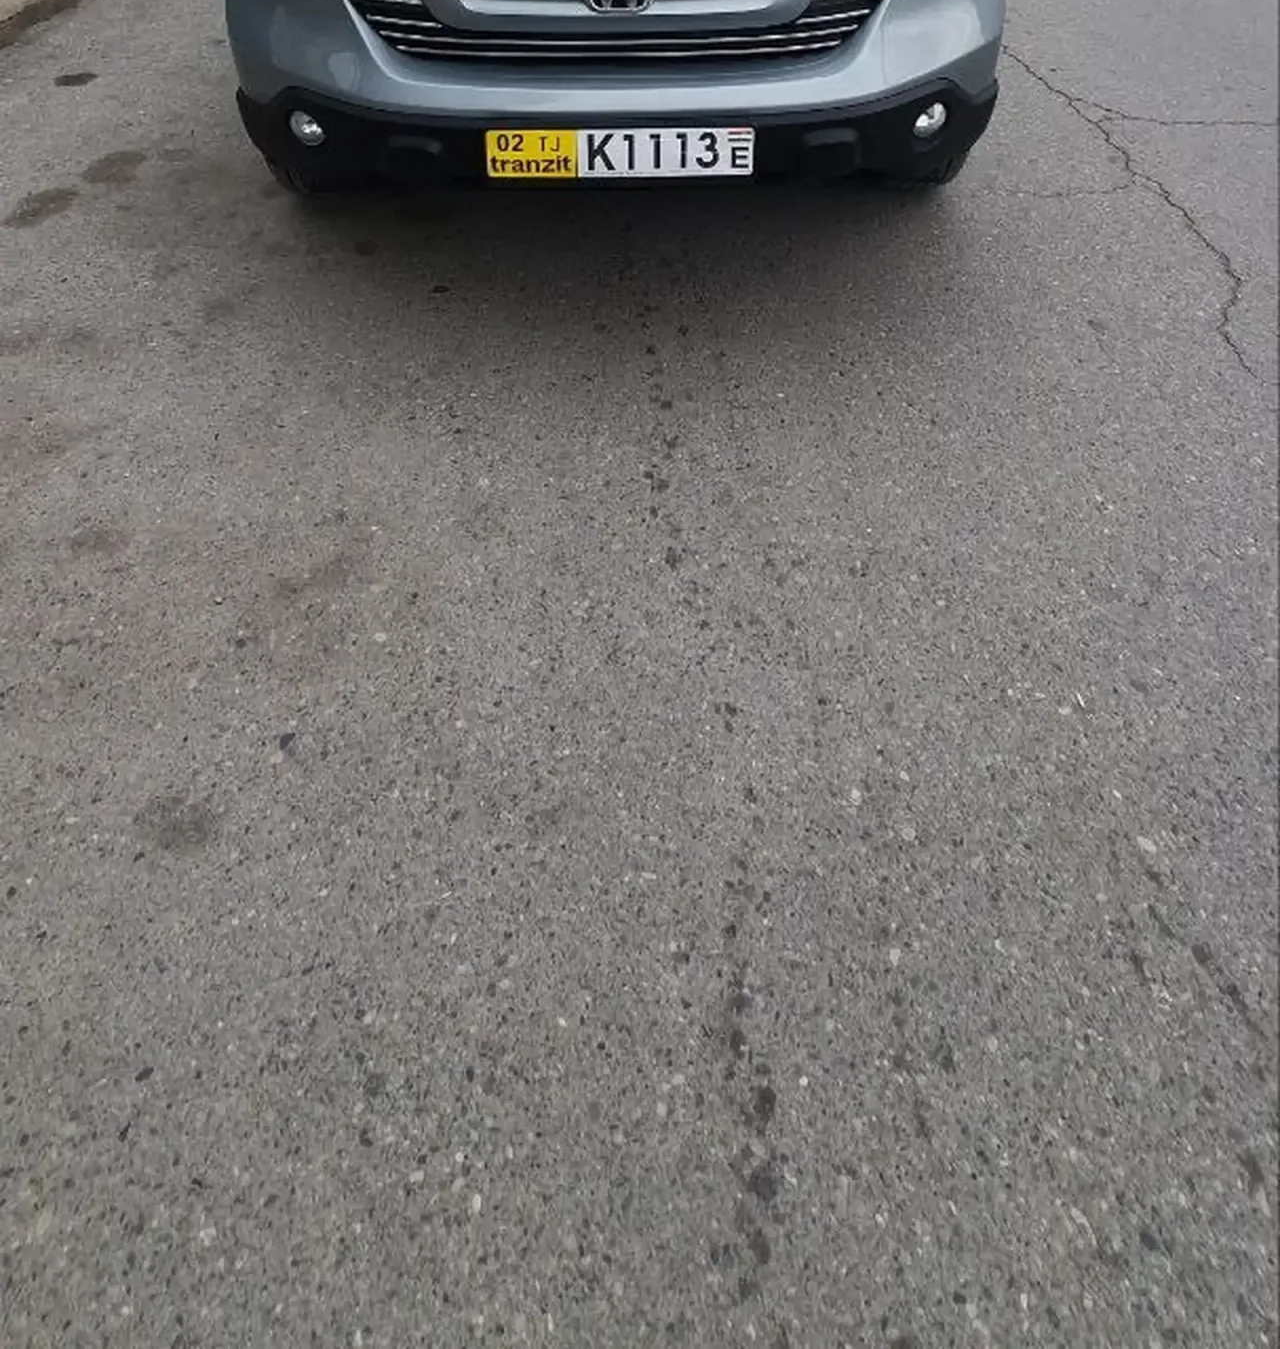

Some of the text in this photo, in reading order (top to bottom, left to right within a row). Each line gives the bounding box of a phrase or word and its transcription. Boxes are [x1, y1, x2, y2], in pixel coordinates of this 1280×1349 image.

[497, 134, 560, 152] 02 TJ
[587, 132, 749, 171] K1113 E
[490, 155, 571, 173] tranzit
